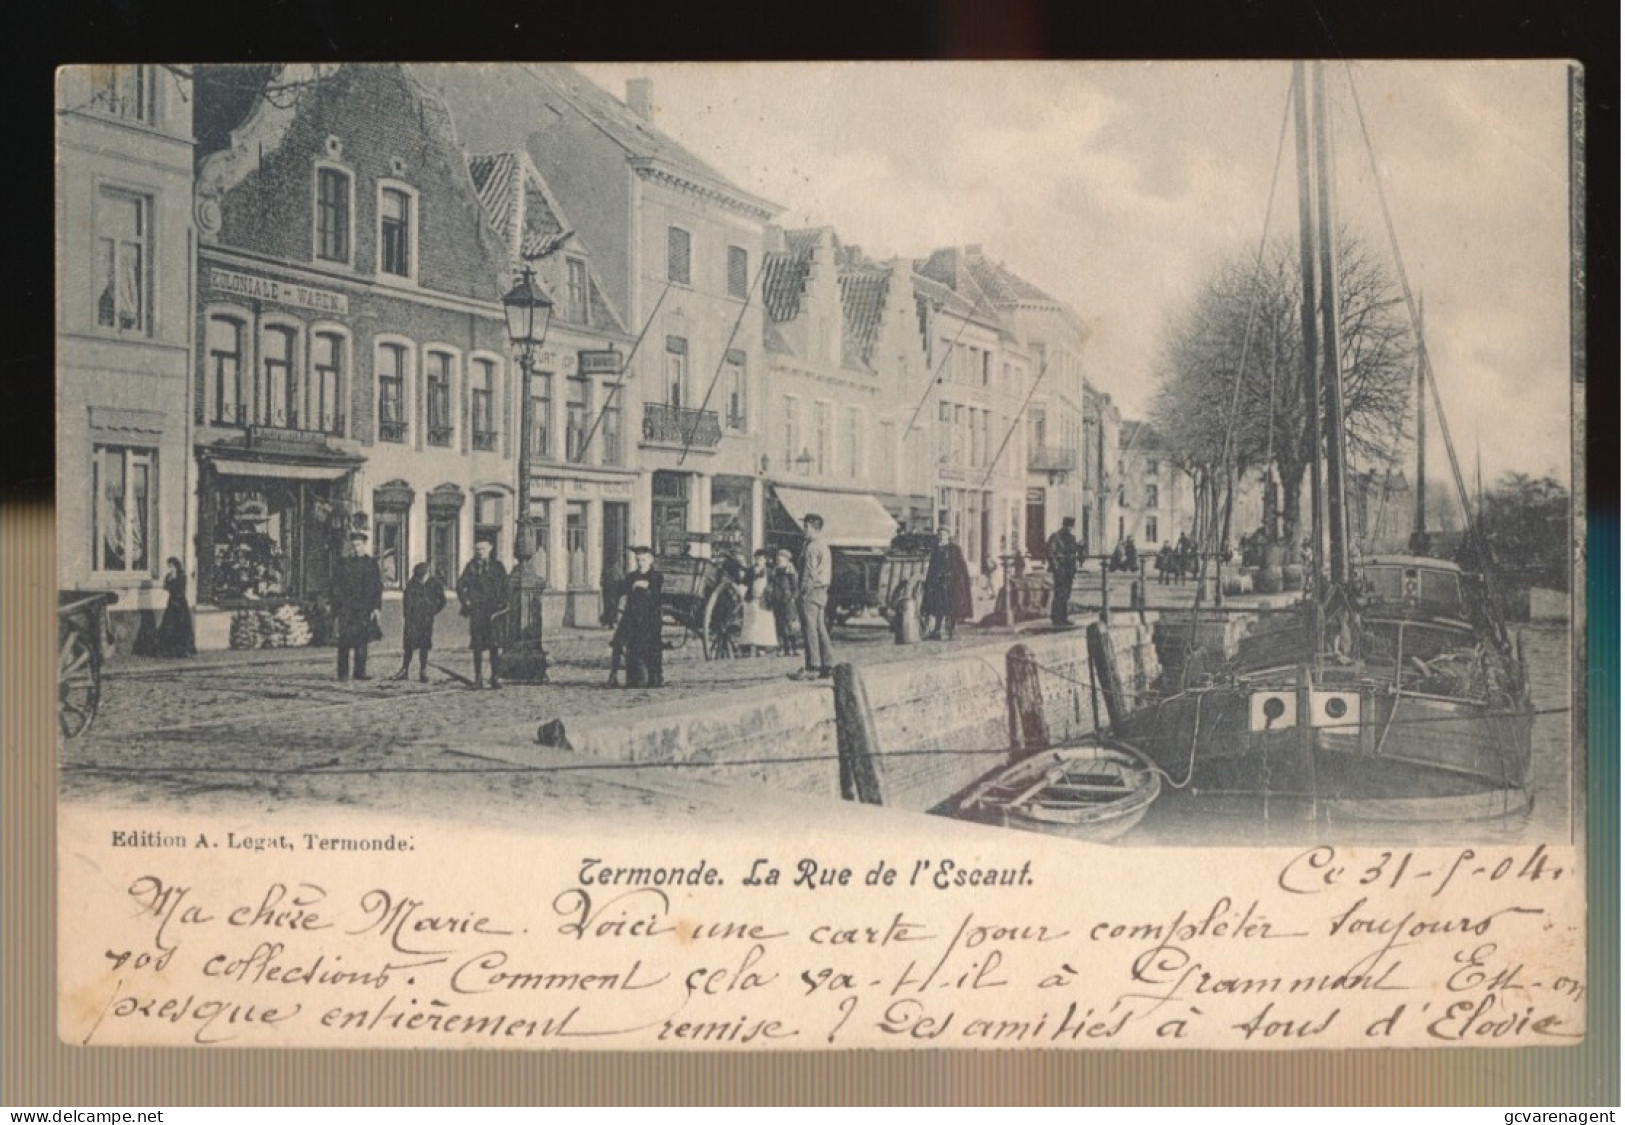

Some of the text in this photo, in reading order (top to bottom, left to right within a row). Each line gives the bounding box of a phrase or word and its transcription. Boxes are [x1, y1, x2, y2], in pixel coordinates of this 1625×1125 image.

[112, 831, 187, 849] Edition
[195, 832, 218, 849] A.
[228, 832, 294, 853] Legat,
[579, 858, 1033, 889] Termonde. La Rue de l'Escaut.
[127, 875, 214, 950] Ma
[691, 914, 789, 941] une
[809, 911, 938, 949] carte
[450, 950, 668, 995] Comment
[1037, 964, 1077, 989] à
[83, 980, 302, 1045] presque
[1156, 1006, 1200, 1039] à
